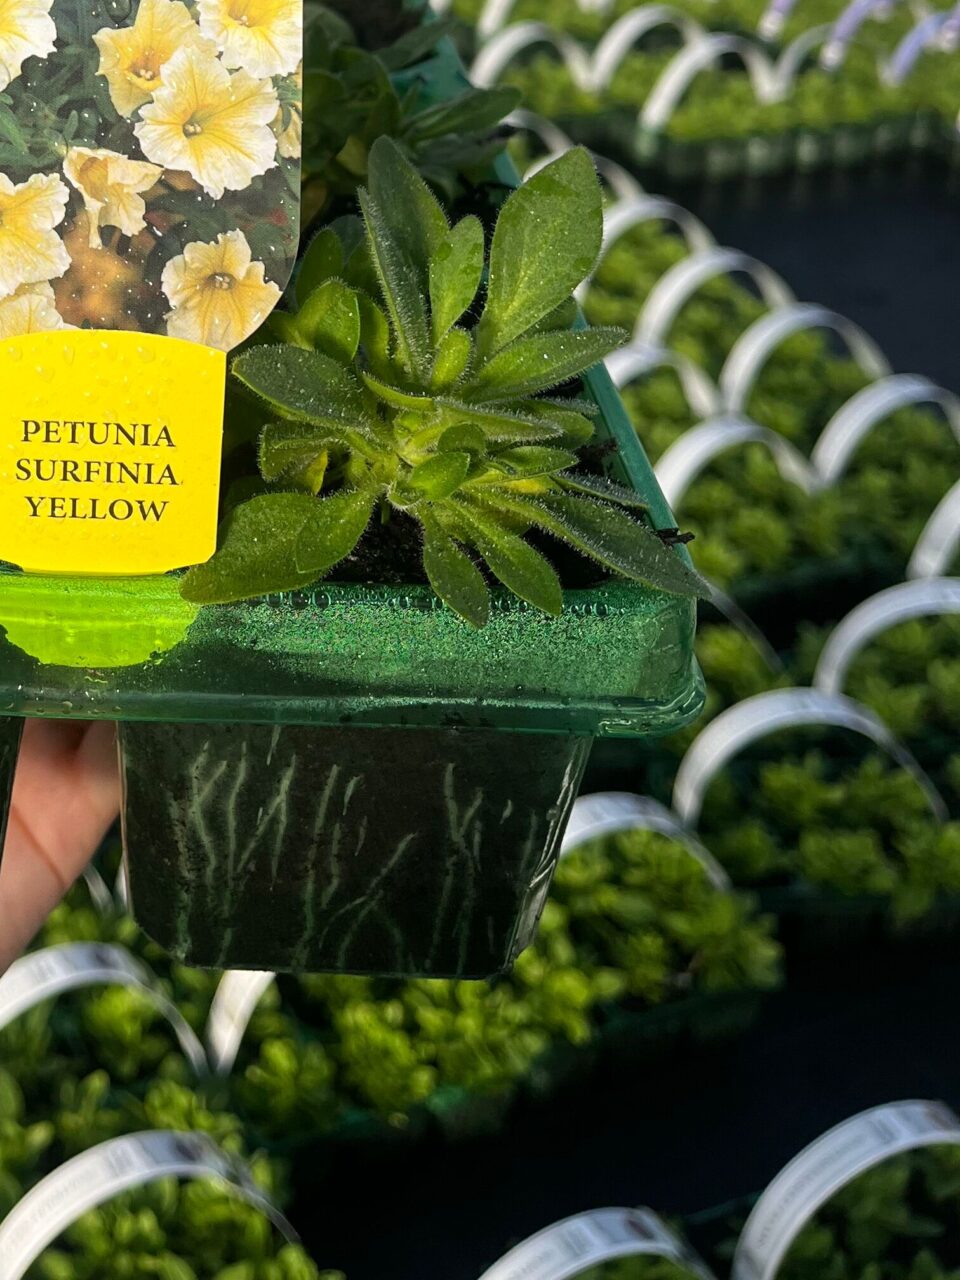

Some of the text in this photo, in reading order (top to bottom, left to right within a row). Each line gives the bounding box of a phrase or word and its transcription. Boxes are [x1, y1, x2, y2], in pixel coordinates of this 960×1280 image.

[21, 420, 176, 448] PETUNIA
[15, 458, 180, 486] SURFINIA
[24, 496, 170, 521] YELLOW
